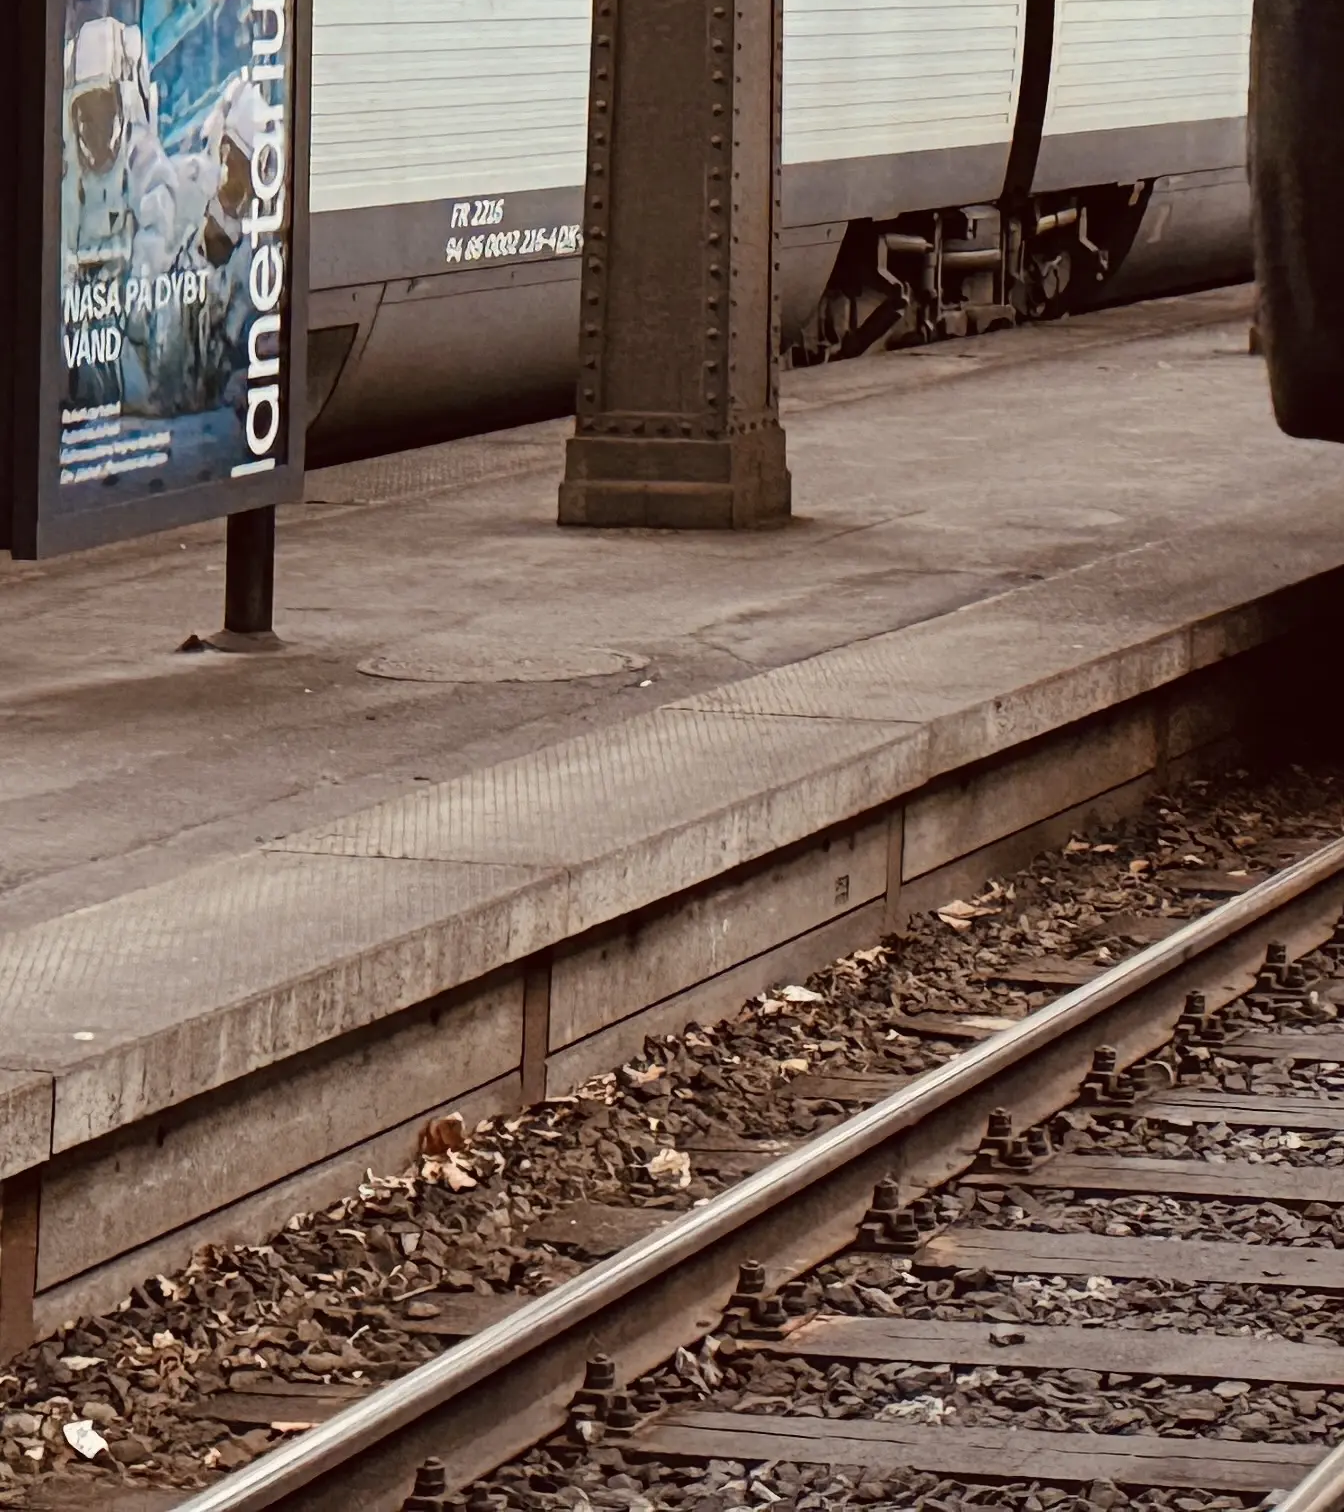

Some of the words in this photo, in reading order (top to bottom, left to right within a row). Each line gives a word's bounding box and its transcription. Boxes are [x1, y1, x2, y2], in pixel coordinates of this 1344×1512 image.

[63, 276, 122, 324] NASA
[124, 264, 152, 317] PÅ
[154, 269, 210, 308] DYBT
[63, 325, 122, 369] VAND
